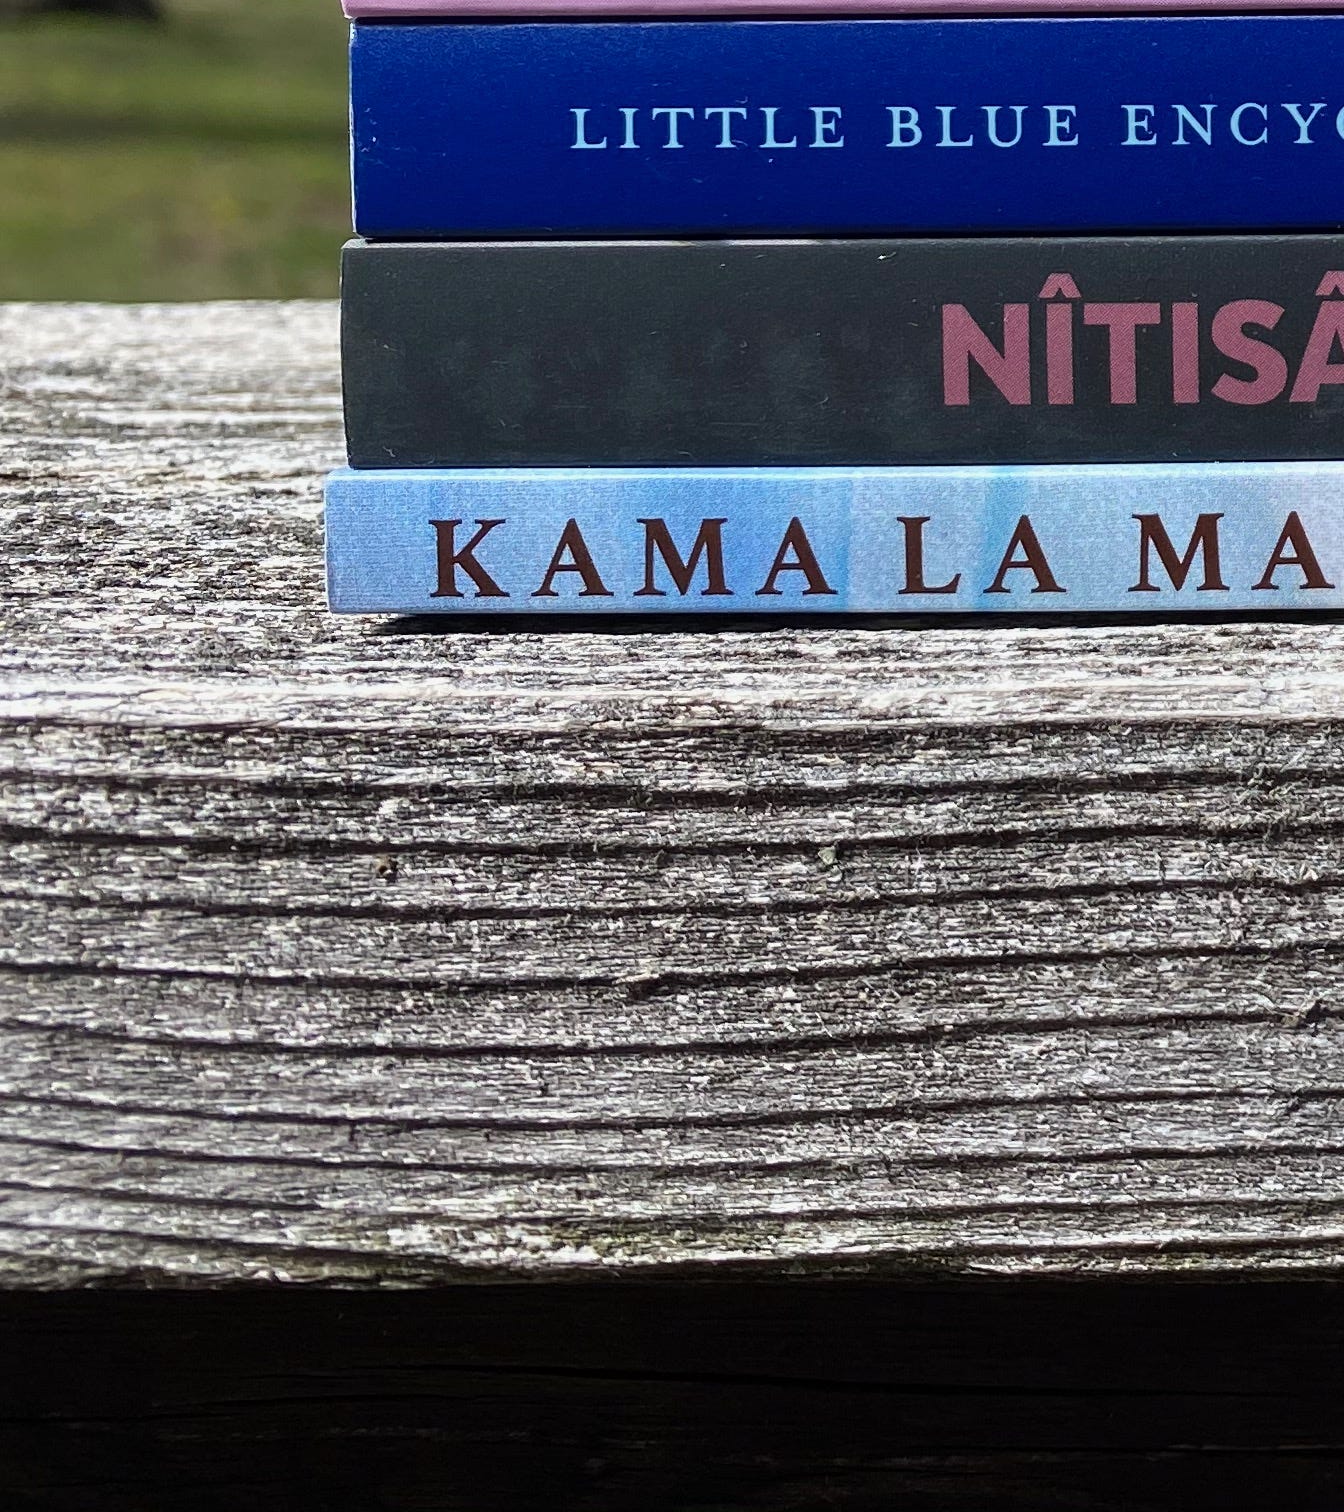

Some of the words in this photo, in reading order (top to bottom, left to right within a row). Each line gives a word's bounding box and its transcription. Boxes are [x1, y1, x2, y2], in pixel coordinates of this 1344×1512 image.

[570, 105, 845, 149] LITTLE
[888, 104, 1081, 147] BLUE
[428, 516, 839, 599] KAMA
[896, 514, 1067, 594] LA
